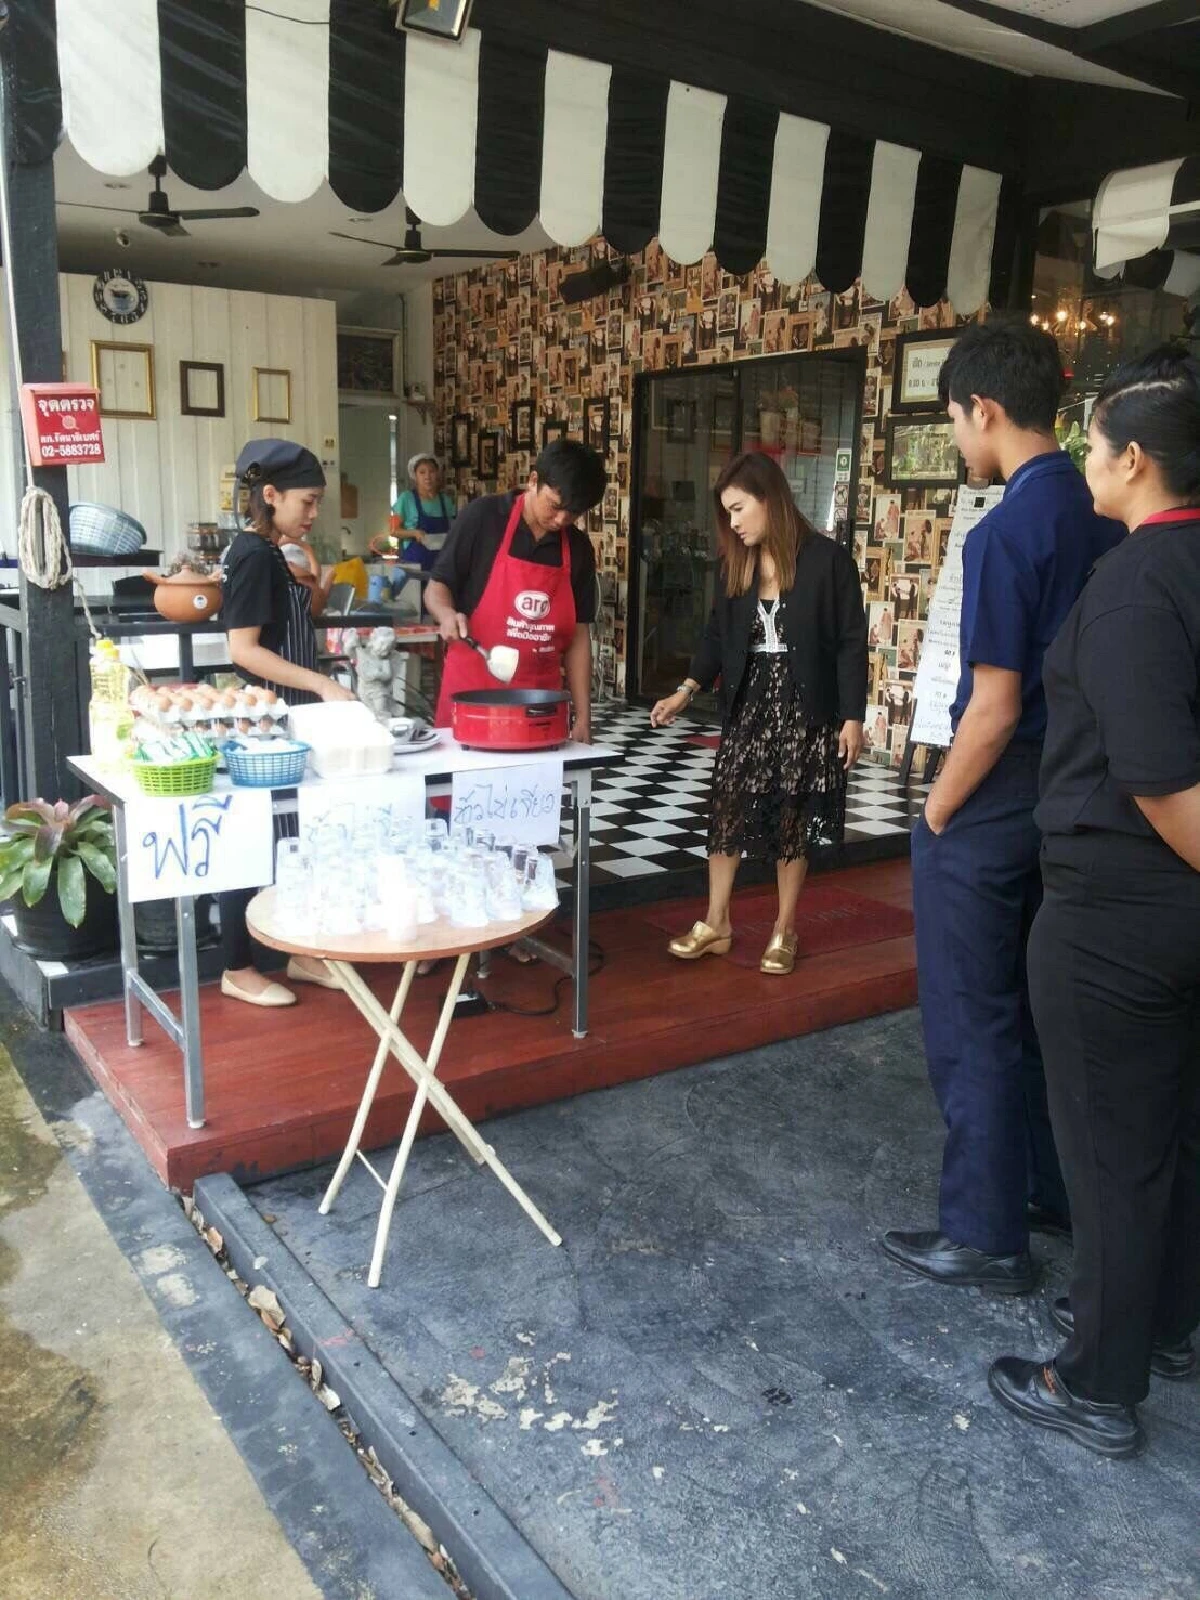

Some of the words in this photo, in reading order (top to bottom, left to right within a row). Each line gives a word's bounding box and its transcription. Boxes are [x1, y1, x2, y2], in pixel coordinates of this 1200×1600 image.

[38, 399, 95, 417] จุดตรวจ
[41, 443, 102, 457] 02-5883728
[142, 794, 233, 880] ฟรี
